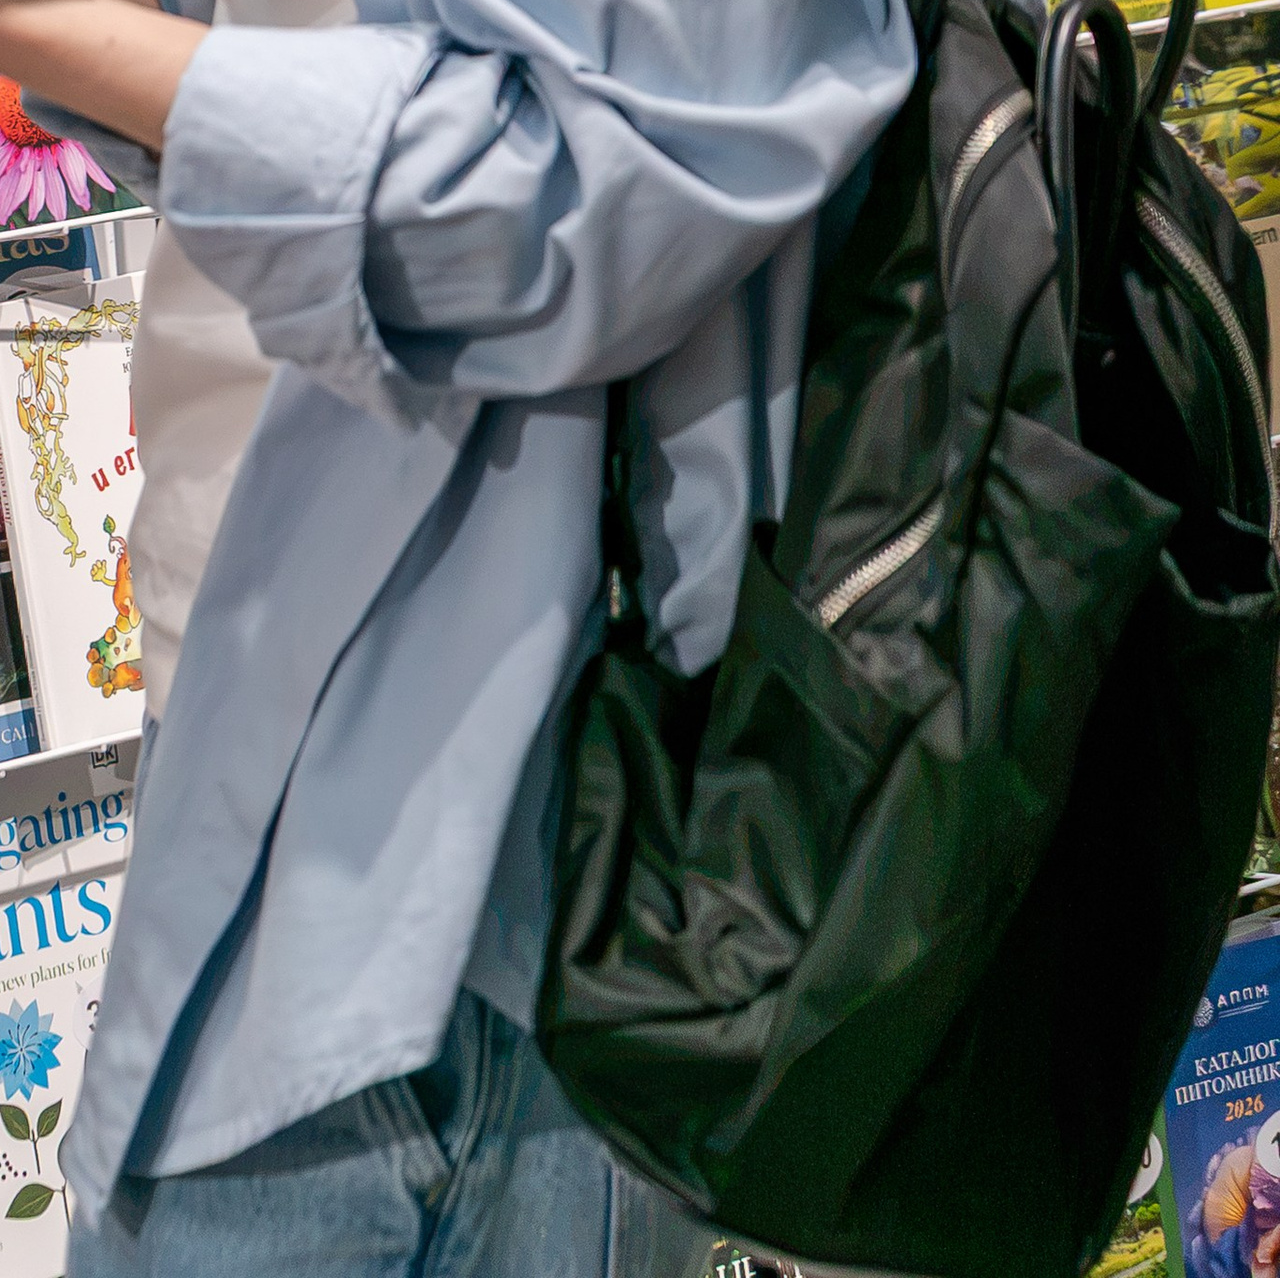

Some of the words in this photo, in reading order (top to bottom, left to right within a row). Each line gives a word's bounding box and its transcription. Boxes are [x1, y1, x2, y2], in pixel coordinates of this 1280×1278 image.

[30, 960, 76, 991] plants
[76, 951, 101, 974] for
[1193, 1039, 1280, 1077] КАТАЛОГ
[1225, 1093, 1266, 1124] 2026
